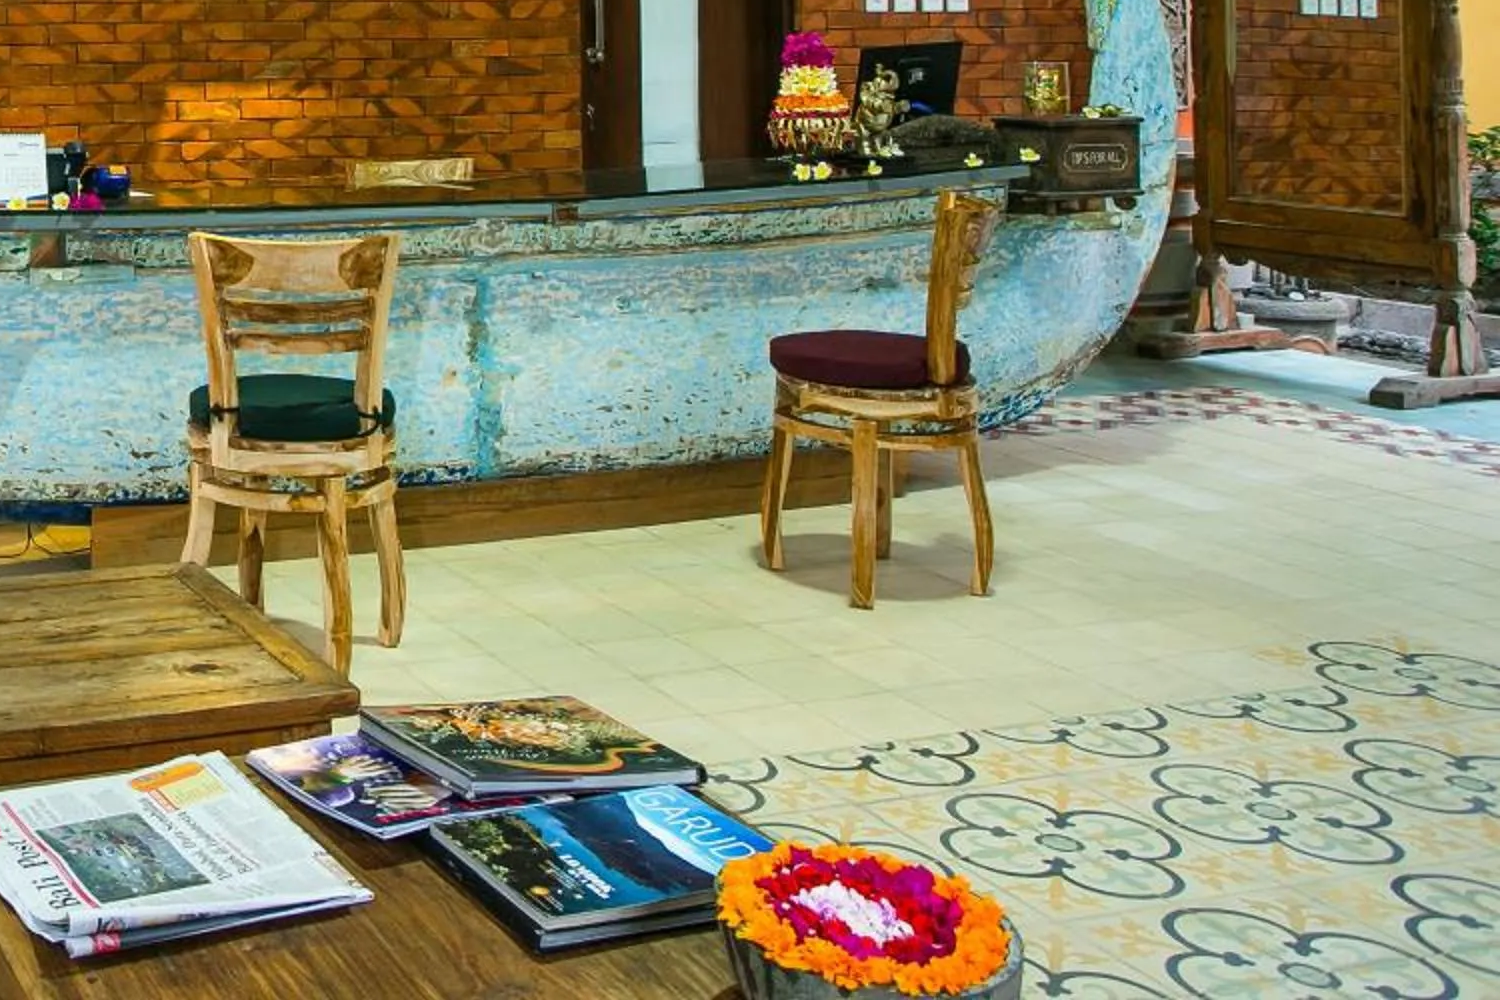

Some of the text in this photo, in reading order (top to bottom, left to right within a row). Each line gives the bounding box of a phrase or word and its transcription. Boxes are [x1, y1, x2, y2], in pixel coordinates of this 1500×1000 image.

[633, 789, 756, 862] GARUD
[7, 839, 82, 909] Bali Post
